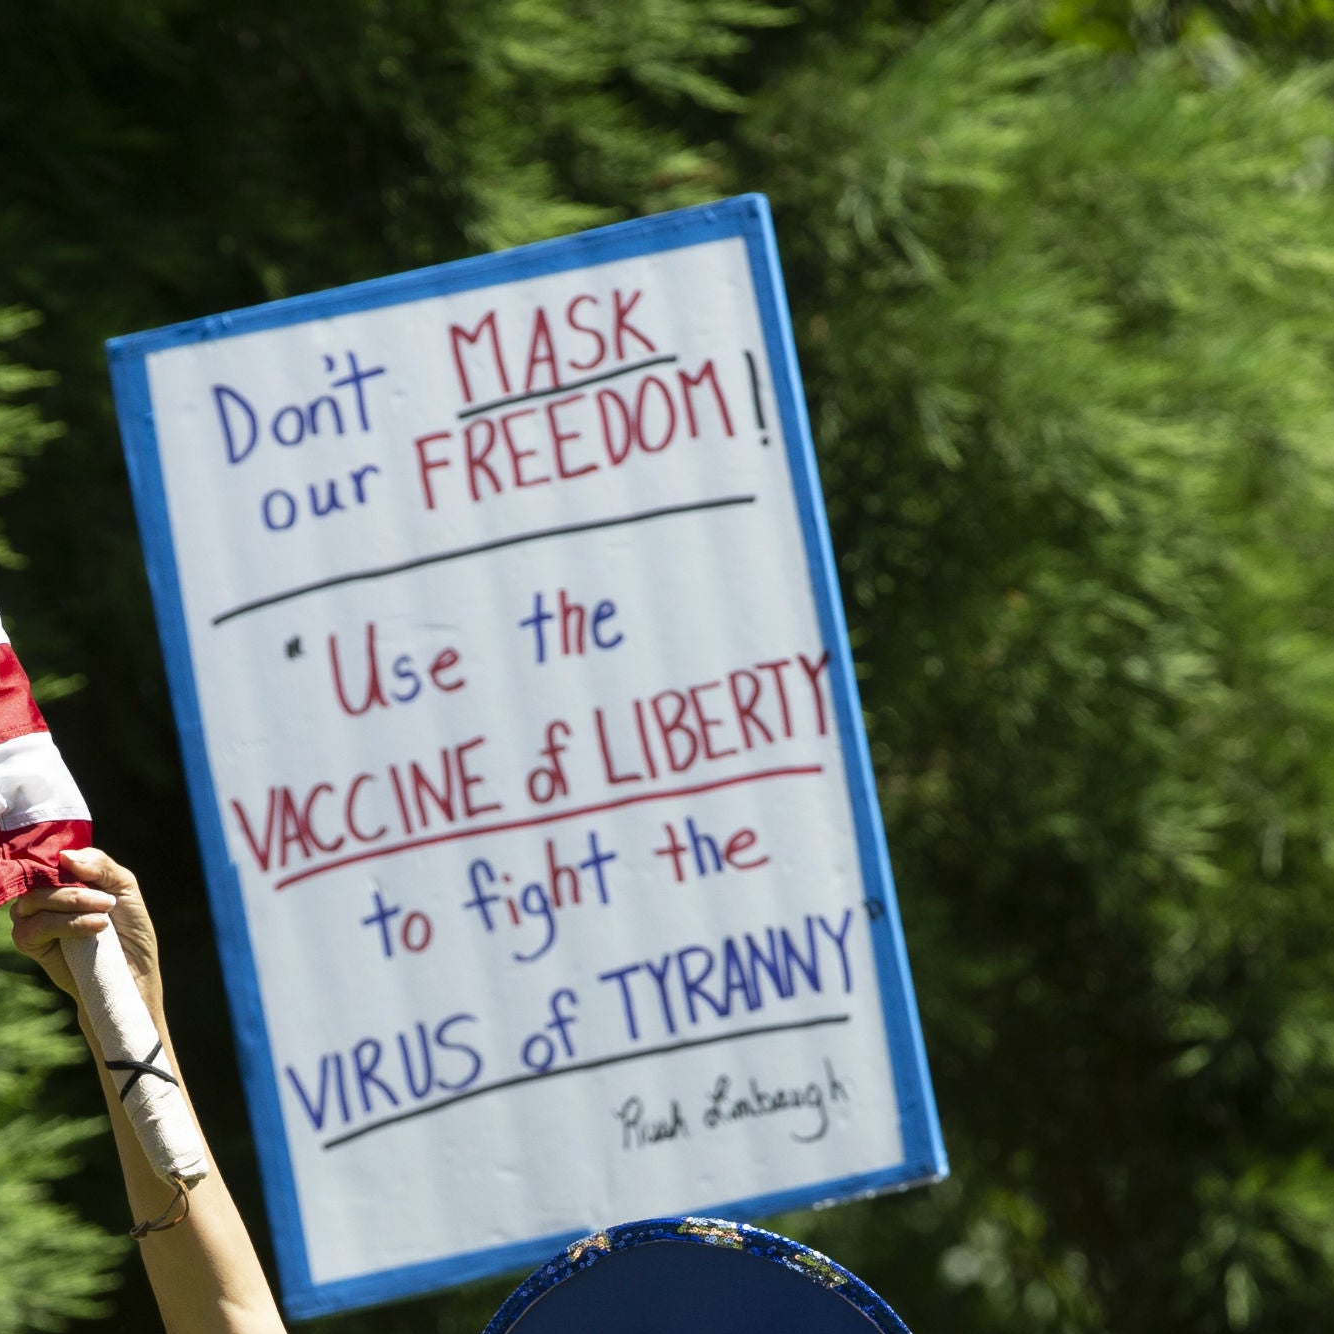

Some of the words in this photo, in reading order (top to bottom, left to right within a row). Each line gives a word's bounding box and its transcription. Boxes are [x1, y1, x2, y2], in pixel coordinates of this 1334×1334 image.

[210, 350, 386, 466] Don't
[447, 288, 658, 405] MASK
[260, 463, 380, 533] our
[518, 589, 625, 665] the
[230, 735, 504, 873] VACCINE
[526, 719, 572, 805] of
[594, 651, 831, 787] LIBERTY
[362, 890, 434, 959] to
[464, 830, 618, 963] fight
[654, 815, 771, 884] the
[285, 1012, 484, 1132] VIRUS
[521, 988, 579, 1074] of
